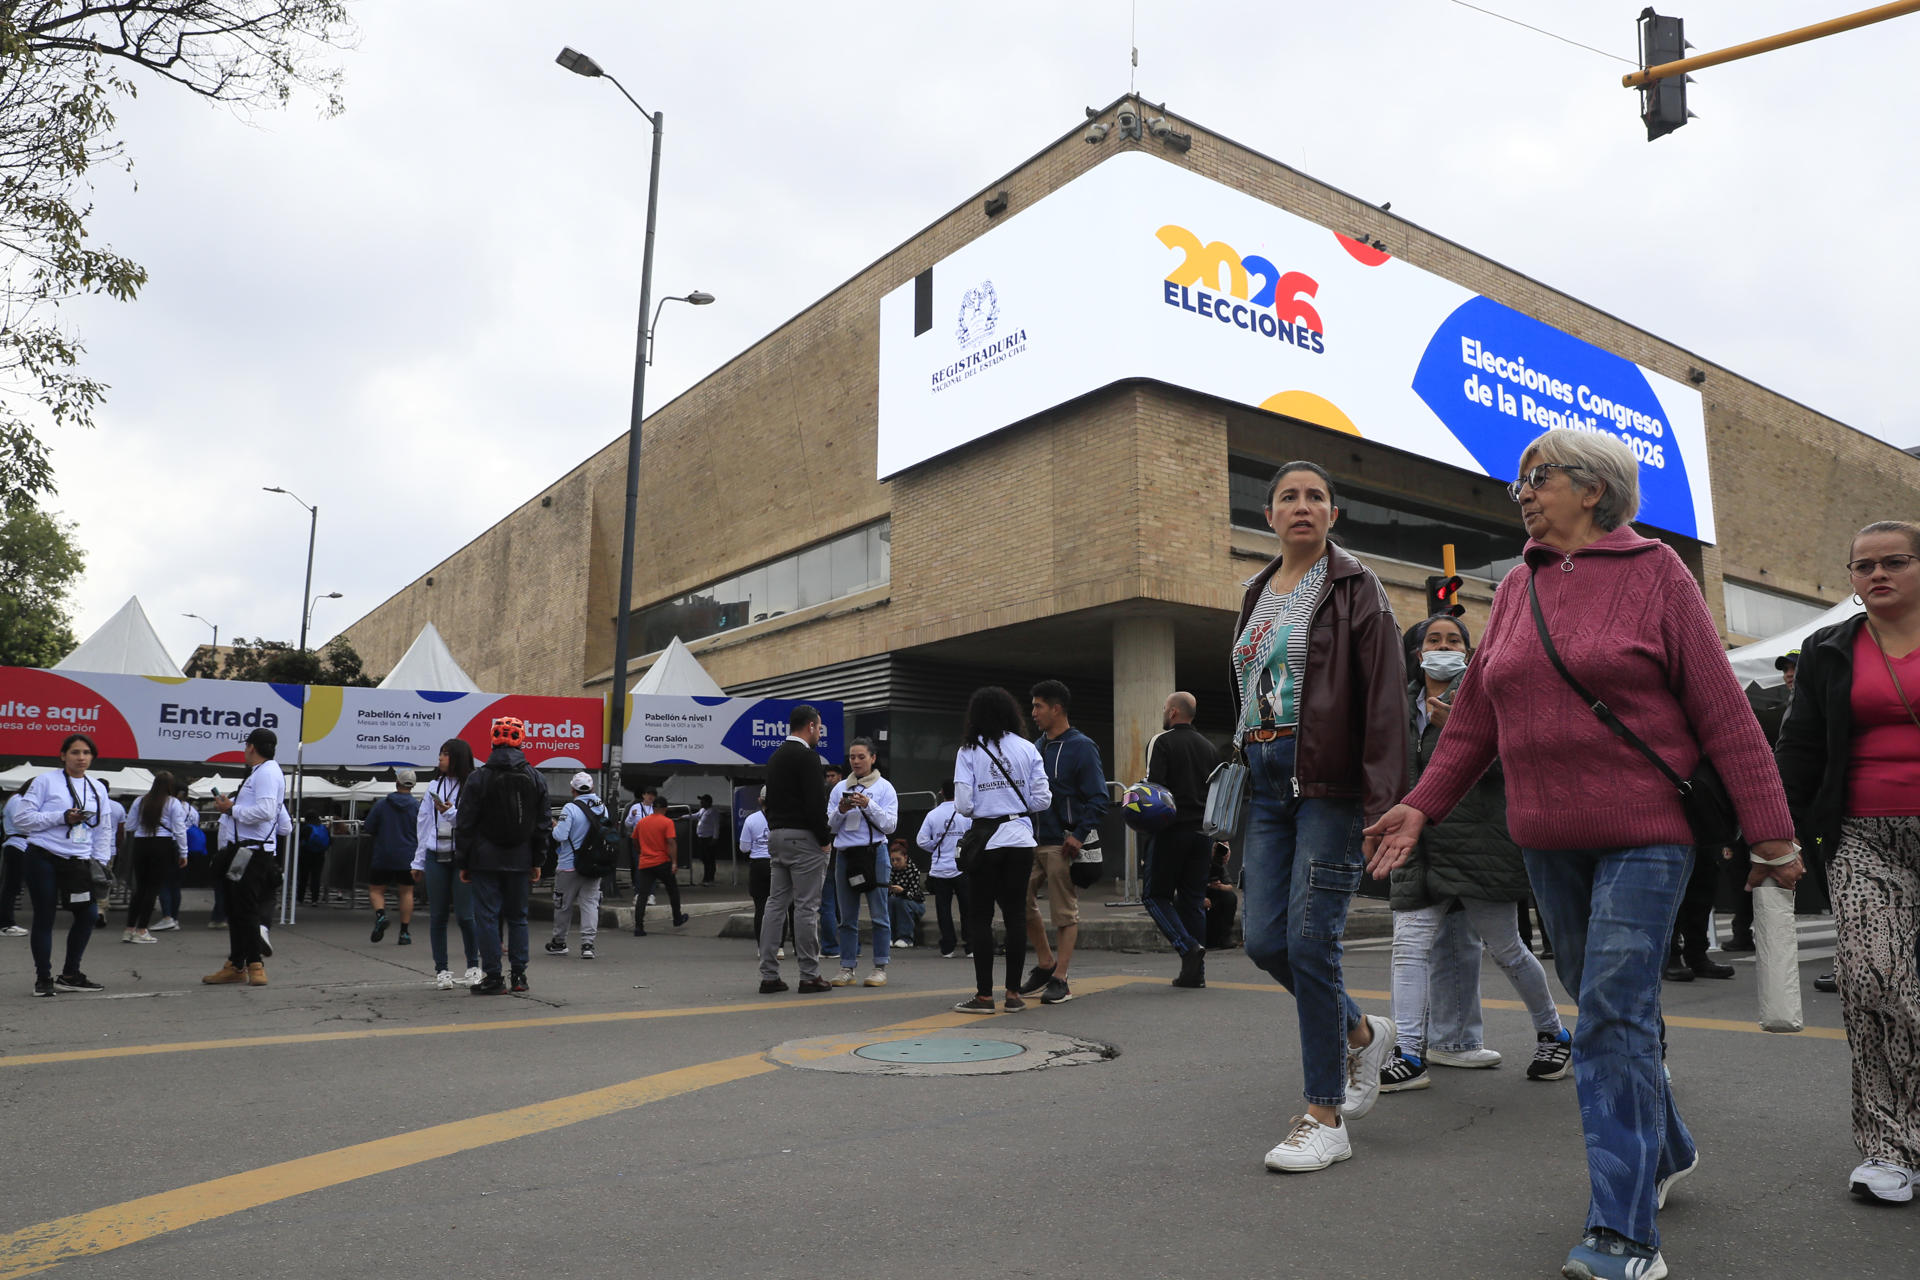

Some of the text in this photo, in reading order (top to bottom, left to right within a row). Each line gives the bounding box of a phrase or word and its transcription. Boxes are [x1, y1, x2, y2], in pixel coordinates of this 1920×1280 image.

[1155, 224, 1323, 336] 2026
[1164, 280, 1325, 354] ELECCIONES
[964, 367, 977, 379] DEL
[979, 353, 1007, 372] ESTADO
[1008, 343, 1027, 358] CIVIL
[1461, 336, 1664, 438] Elecciones Congreso
[1464, 374, 1493, 407] de
[1497, 384, 1518, 417] la
[1521, 394, 1617, 440] Repúbli
[46, 704, 101, 723] aquí
[160, 703, 279, 729] Entrada
[357, 710, 442, 720] Pabellón 4 nivel 1
[645, 713, 680, 721] Pabellón
[0, 721, 96, 733] esa de votación
[158, 727, 251, 743] Ingreso muje
[492, 718, 585, 739] trada
[751, 719, 828, 737] Entra
[356, 734, 410, 743] Gran Salón
[535, 740, 581, 752] mujeres
